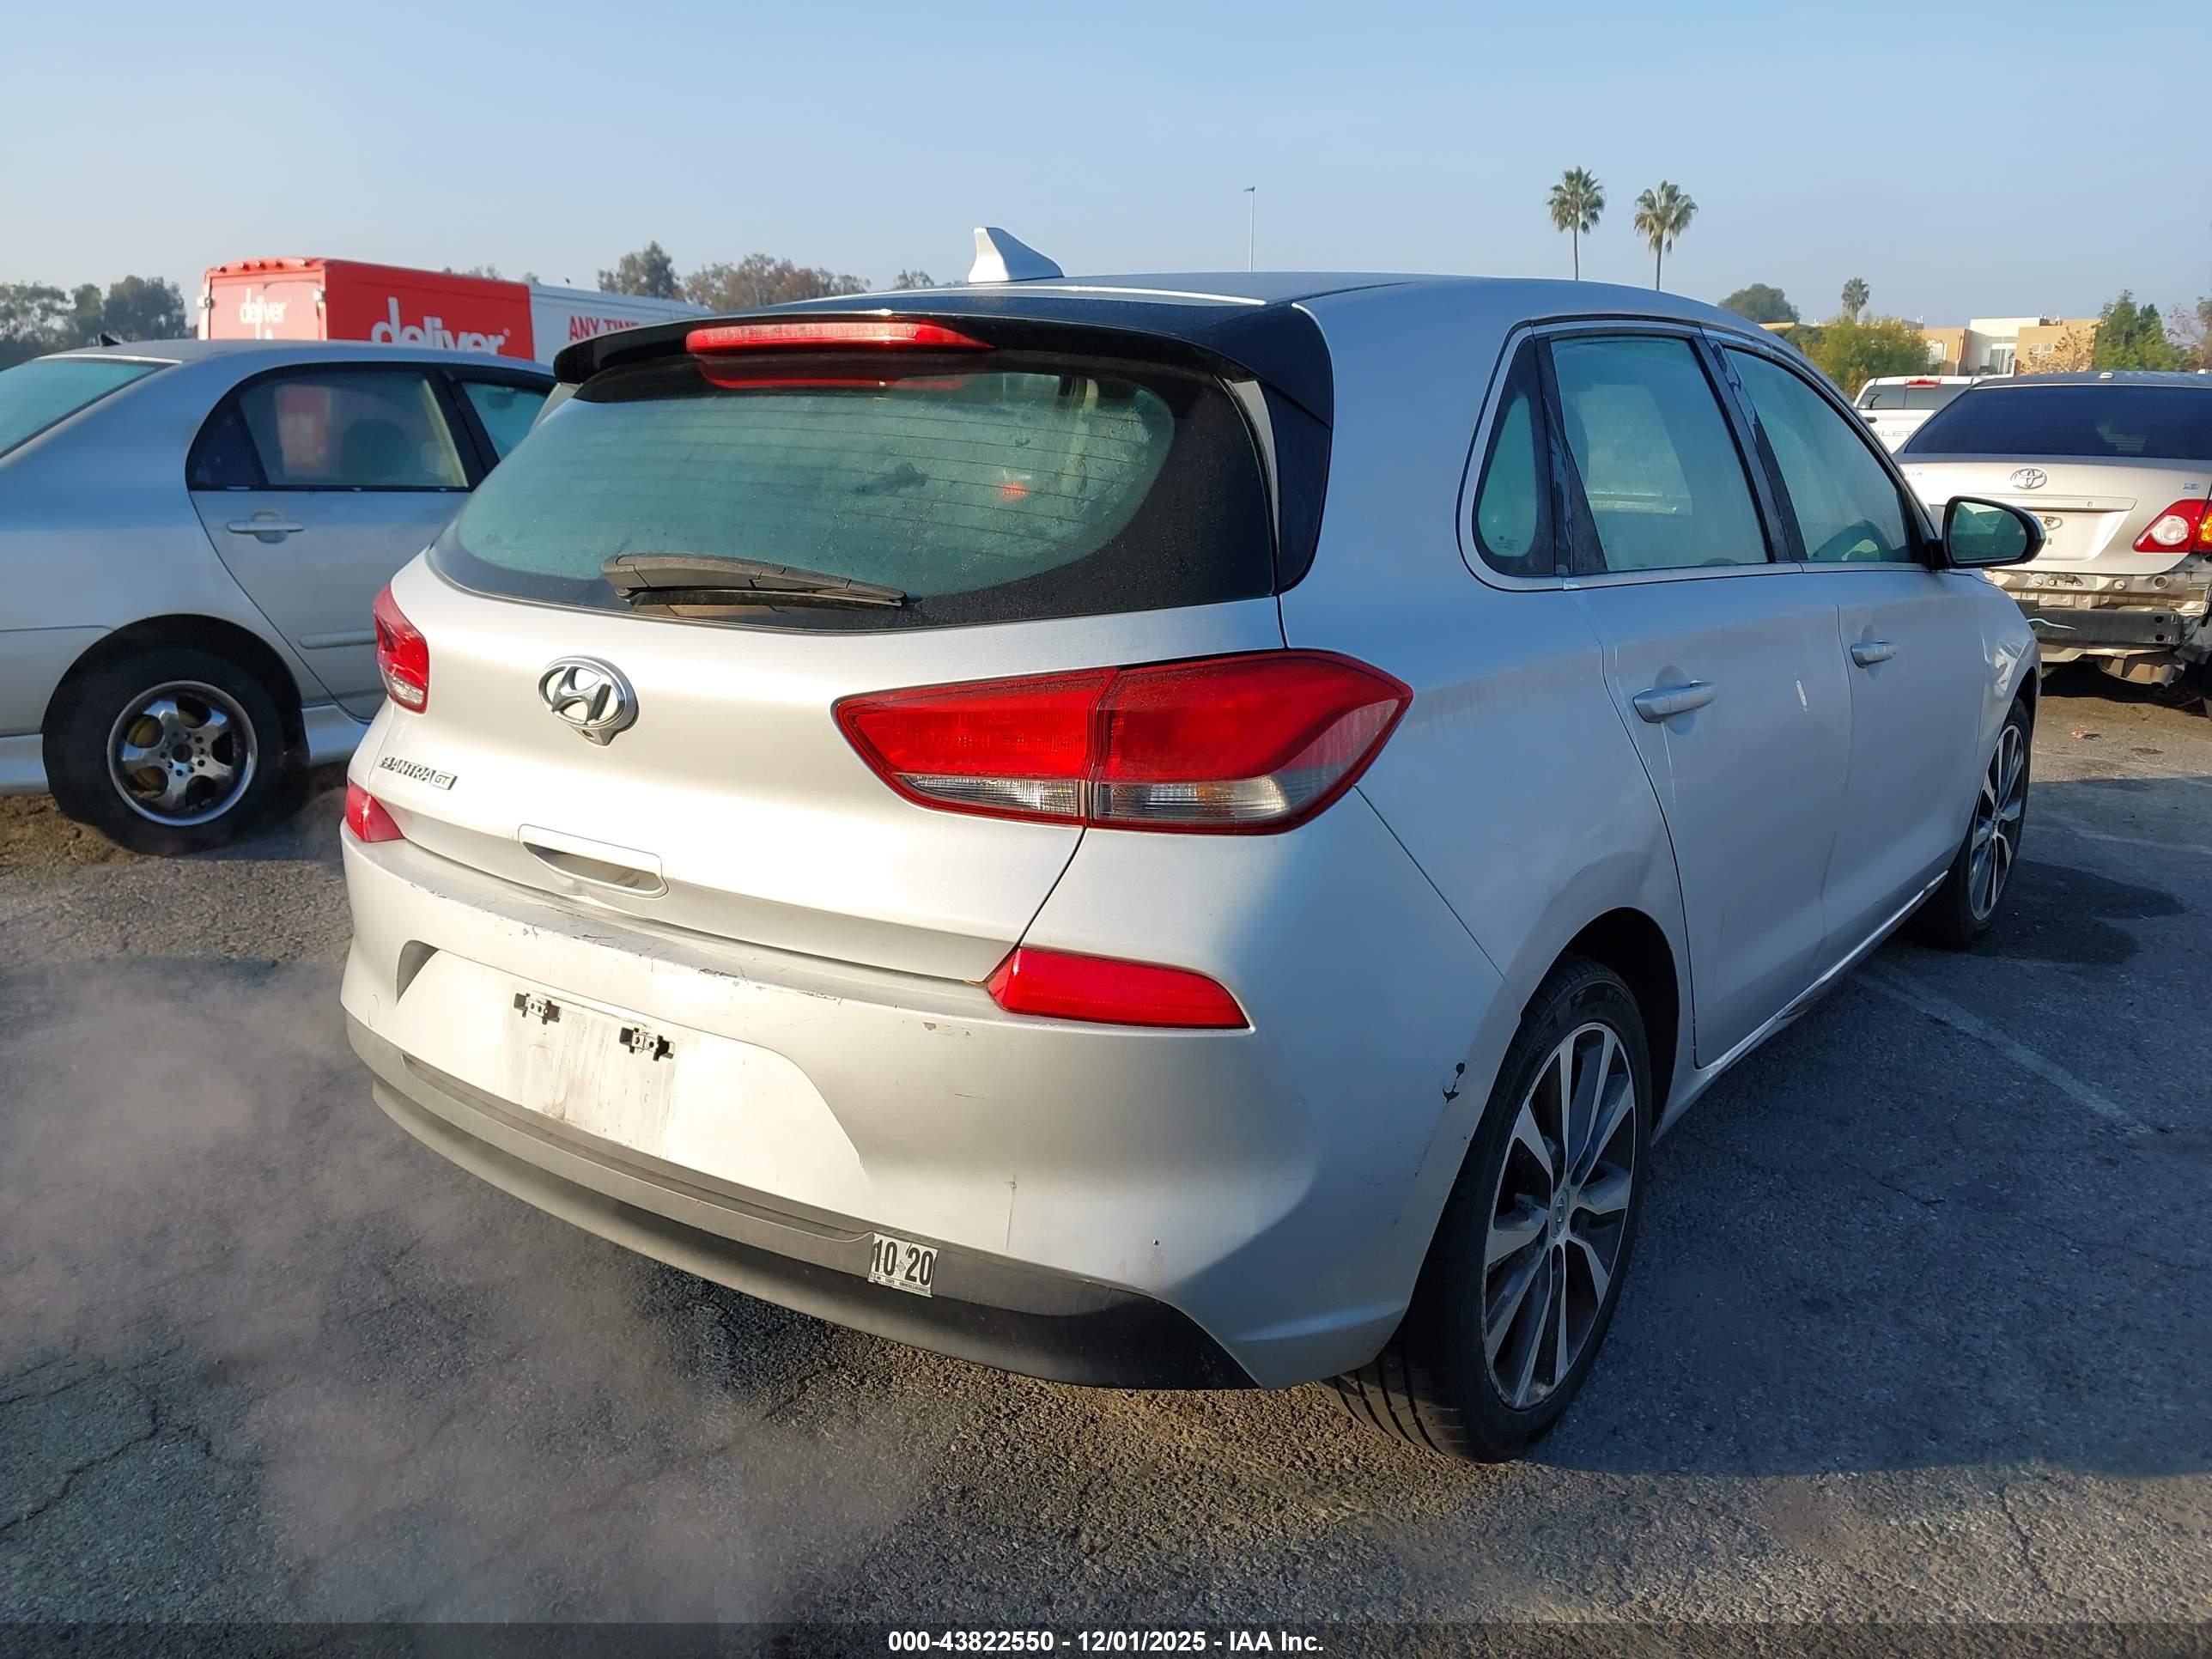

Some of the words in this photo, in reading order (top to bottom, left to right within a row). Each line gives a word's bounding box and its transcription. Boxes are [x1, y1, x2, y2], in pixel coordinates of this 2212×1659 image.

[240, 288, 287, 325] deliver
[569, 315, 600, 342] ANY
[379, 757, 431, 781] ELANTRA
[874, 1239, 897, 1276] 10
[905, 1248, 933, 1285] 20
